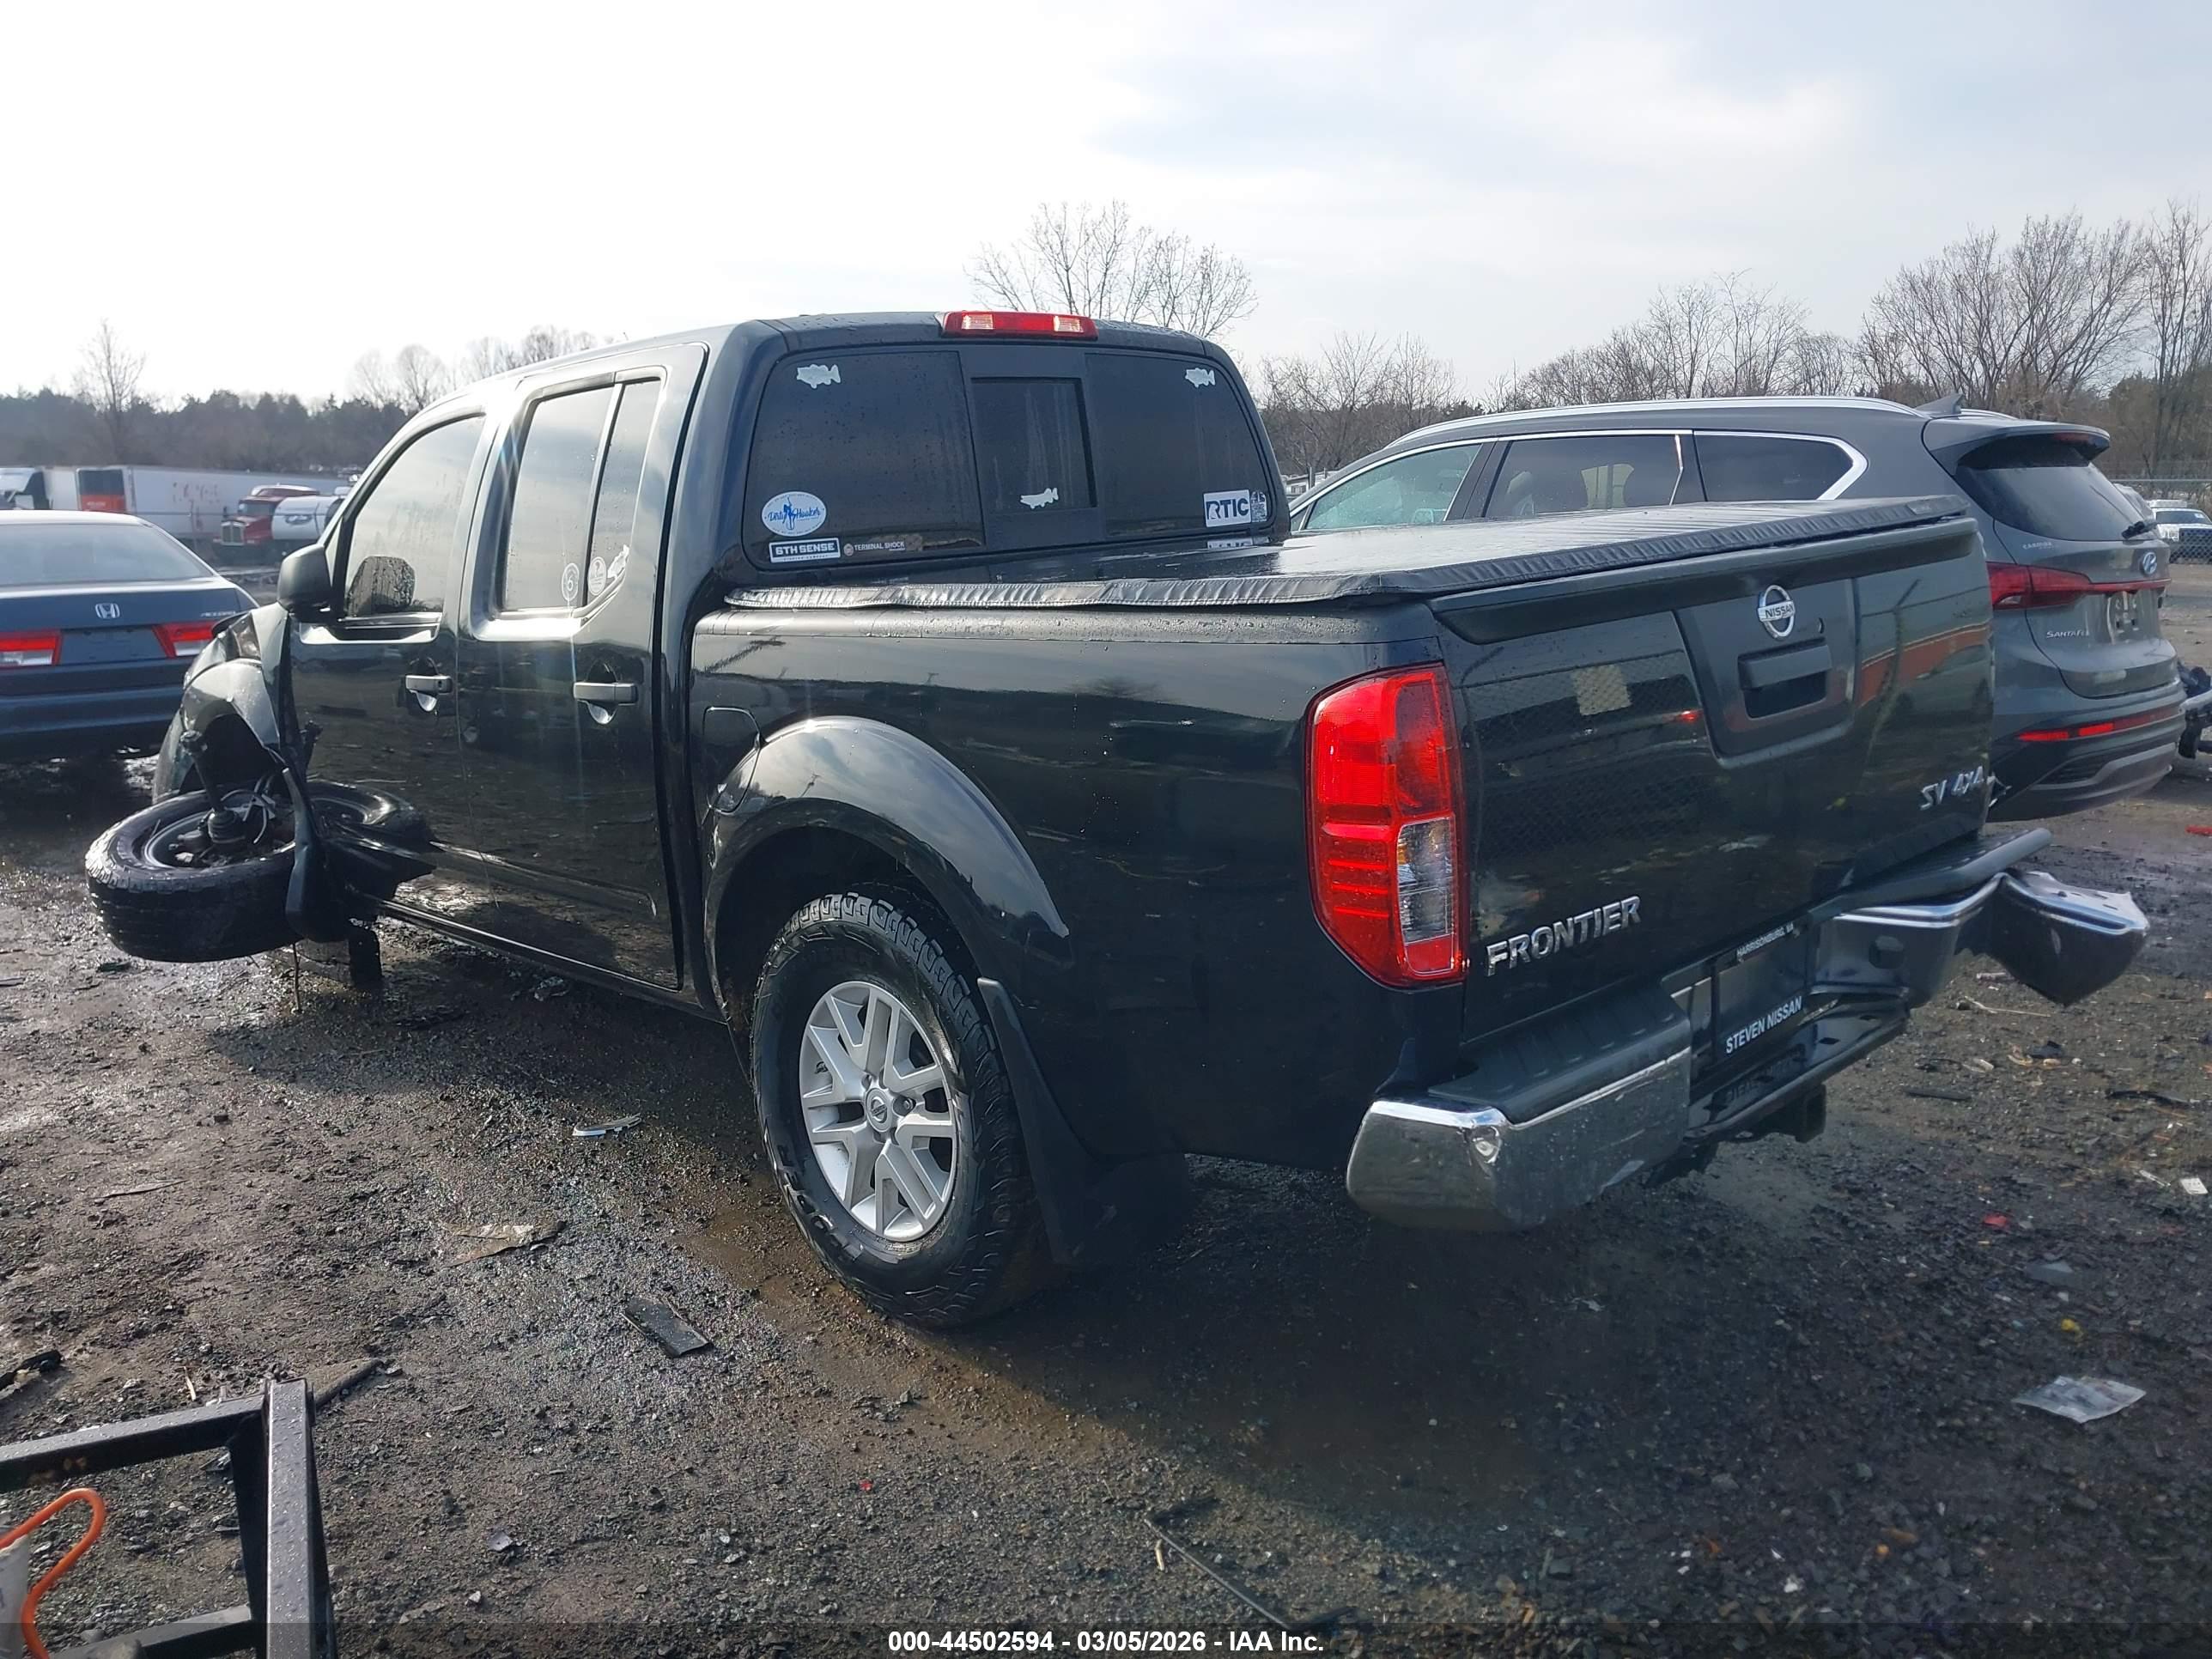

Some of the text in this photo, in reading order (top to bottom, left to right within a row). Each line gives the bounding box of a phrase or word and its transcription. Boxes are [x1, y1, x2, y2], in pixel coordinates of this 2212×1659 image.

[1206, 497, 1249, 520] RTIC
[775, 542, 836, 556] 6TH SENSE
[854, 541, 905, 551] TERMINAL SHOCK
[1765, 604, 1794, 619] NISSAN
[1919, 780, 1948, 811] SV
[1486, 895, 1641, 977] FRONTIER
[1726, 995, 1802, 1054] STEVEN NISSAN
